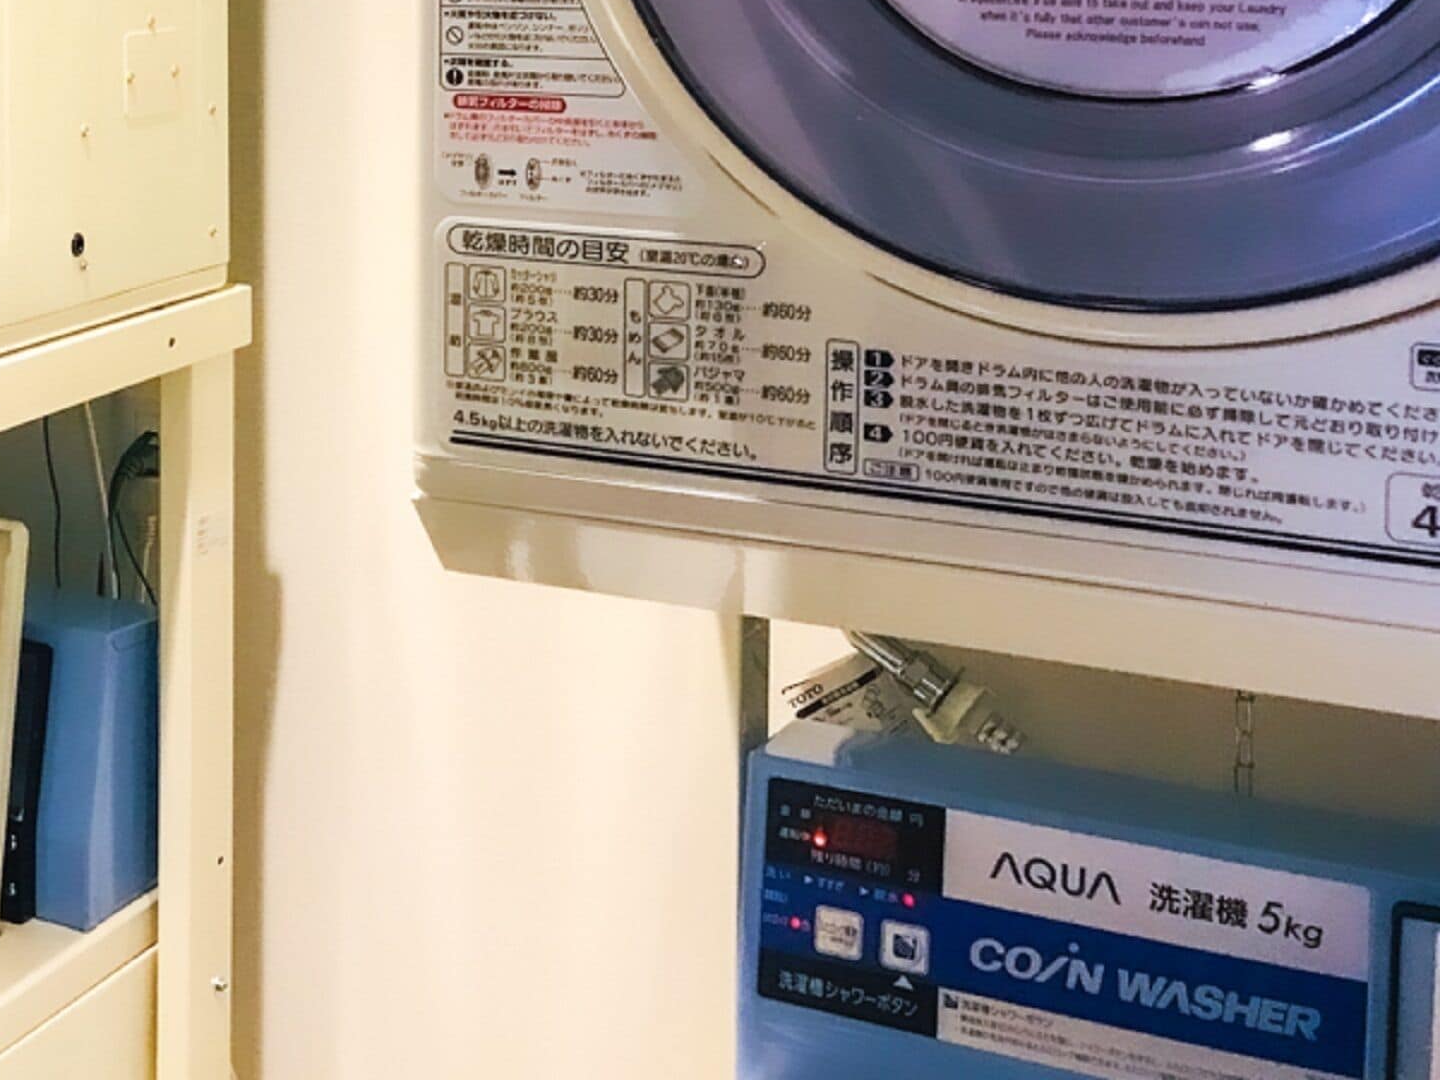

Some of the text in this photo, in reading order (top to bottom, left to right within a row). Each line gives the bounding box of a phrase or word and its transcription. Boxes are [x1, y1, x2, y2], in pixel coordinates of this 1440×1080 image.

[462, 229, 630, 265] 乾燥時間の目安
[511, 307, 558, 323] ブラウス
[573, 285, 619, 304] 約30分
[573, 325, 619, 345] 約30分
[830, 348, 854, 465] 操作順序
[989, 851, 1122, 906] AQUA
[1148, 881, 1324, 950] 洗濯機 5kg
[1116, 966, 1324, 1042] WASHER
